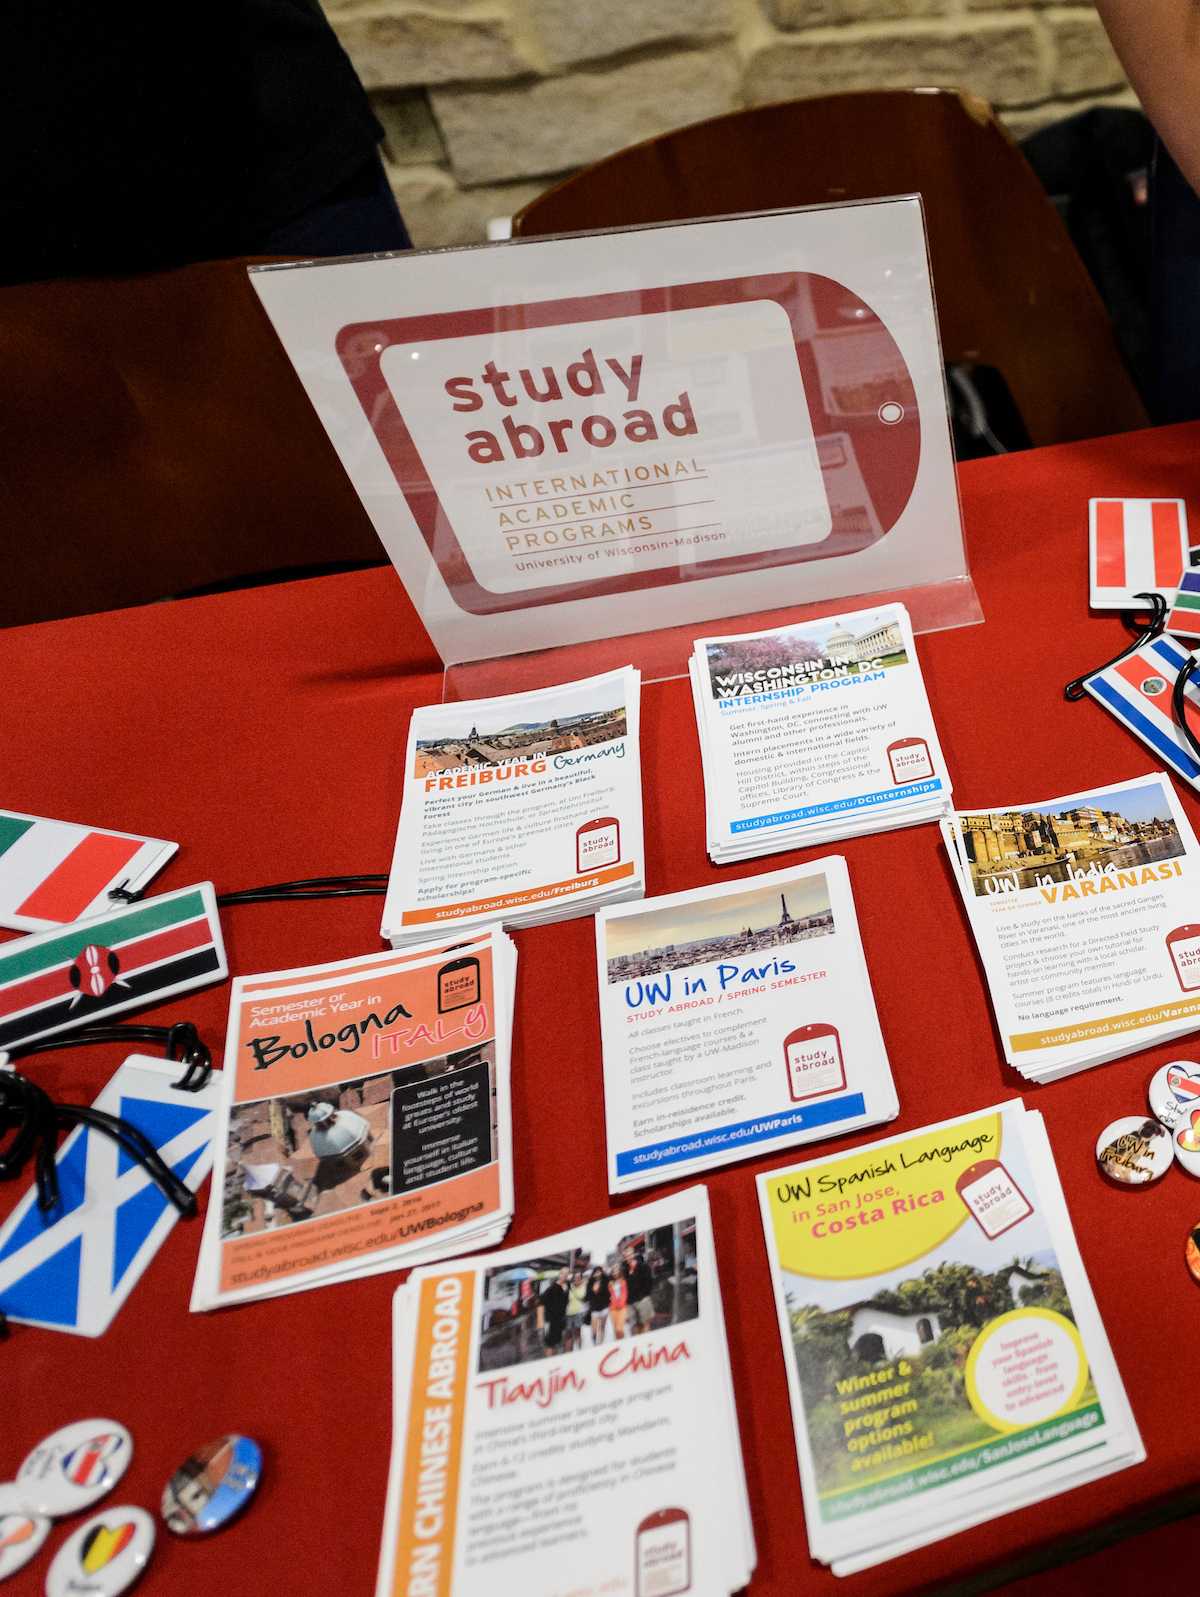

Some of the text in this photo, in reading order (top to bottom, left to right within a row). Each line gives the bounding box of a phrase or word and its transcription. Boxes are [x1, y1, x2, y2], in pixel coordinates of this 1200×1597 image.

[444, 348, 643, 412] study
[464, 391, 699, 464] abroad
[484, 457, 706, 502] INTERNATIONAL
[498, 493, 636, 527] ACADEMIC
[506, 515, 653, 550] PROGRAMS
[514, 530, 727, 571] University of Wisconsin-Madison
[715, 654, 849, 687] WISCONSIN IN
[716, 658, 884, 699] WASHINGTON, DC
[718, 670, 885, 708] INTERNSHIP PROGRAM
[720, 706, 758, 716] Summer,
[760, 701, 787, 710] Spring
[747, 715, 789, 727] first-hand
[791, 706, 838, 719] experience
[424, 742, 625, 793] FREIBURG Germany
[426, 750, 547, 778] ACADEMIC YEAR IN
[895, 752, 920, 763] study
[895, 755, 926, 767] abroad
[424, 796, 454, 805] Perfect
[457, 793, 476, 801] your
[478, 787, 511, 796] German
[554, 768, 592, 781] beautiful,
[735, 783, 937, 830] studyabroad.wisc.edu/DCinternships
[582, 834, 609, 847] study
[582, 839, 614, 853] abroad
[983, 860, 1119, 896] UW in India
[1039, 860, 1183, 904] VARANASI
[435, 876, 599, 918] studyabroad.wisc.edu/Freiburg
[444, 975, 469, 988] study
[444, 978, 474, 993] abroad
[625, 956, 795, 1007] UW in Paris
[626, 970, 826, 1023] STUDY ABROAD SPRING SEMESTER
[248, 993, 381, 1028] Academic Year in
[249, 991, 345, 1018] Semester or
[1031, 1006, 1070, 1019] language
[1071, 996, 1124, 1011] requirement.
[246, 1004, 412, 1071] Bologna
[794, 1049, 827, 1064] study
[794, 1055, 835, 1072] abroad
[633, 1113, 802, 1165] studyabroad.wisc.edu/UWParis
[1143, 1146, 1155, 1161] in
[777, 1133, 993, 1202] UW Spanish Language
[792, 1186, 899, 1223] in San Jose,
[972, 1184, 1001, 1205] study
[977, 1187, 1013, 1213] abroad
[811, 1189, 944, 1238] Costa Rica
[427, 1277, 462, 1398] ABROAD
[476, 1339, 691, 1409] Tianjin, China
[835, 1359, 912, 1398] Winter &
[839, 1379, 911, 1415] summer
[843, 1398, 918, 1436] program
[846, 1419, 913, 1455] options
[413, 1403, 452, 1541] CHINESE
